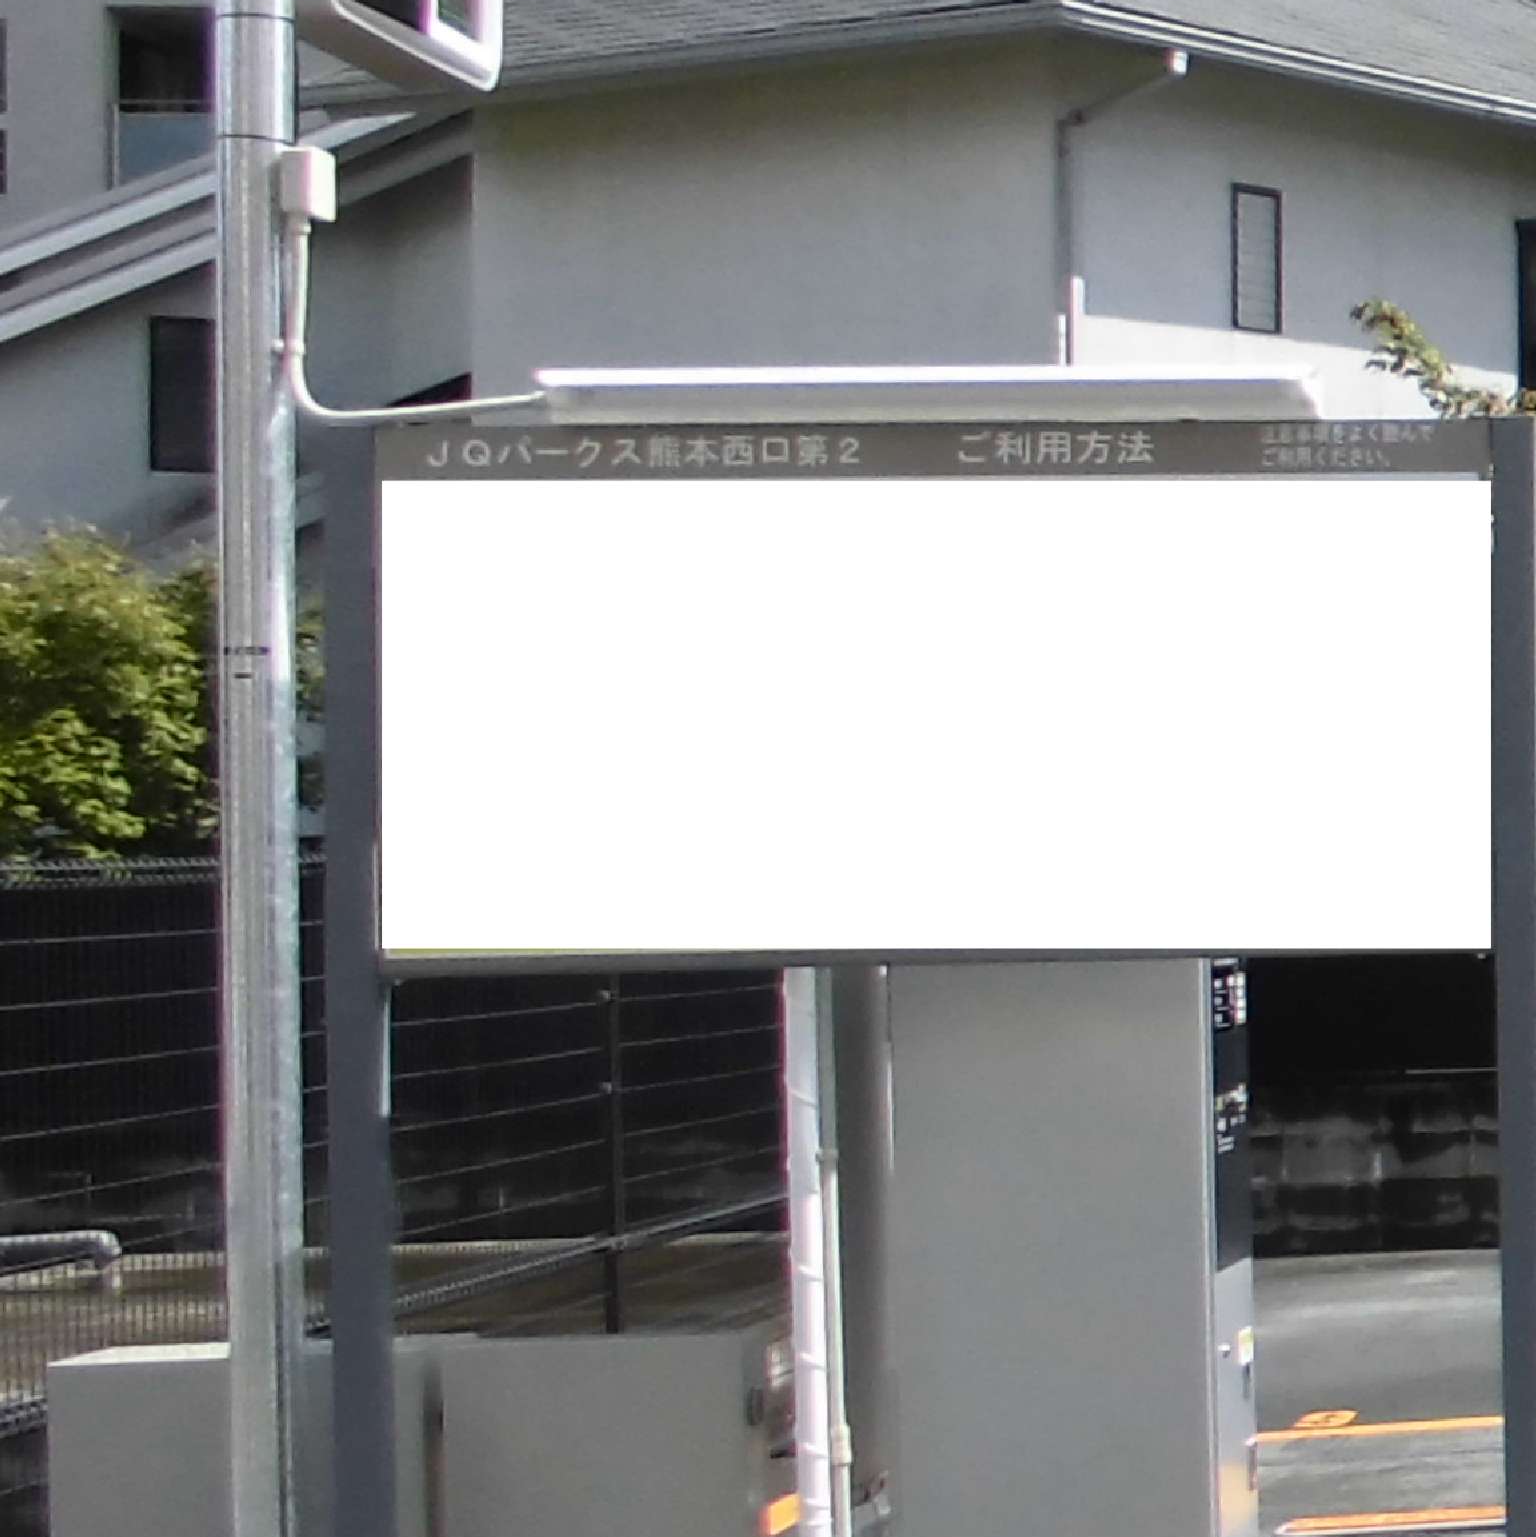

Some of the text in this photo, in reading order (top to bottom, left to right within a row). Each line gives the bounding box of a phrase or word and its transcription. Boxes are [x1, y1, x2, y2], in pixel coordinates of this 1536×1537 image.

[427, 430, 1155, 468] JQパークス熊本西口第2 ご利用方法
